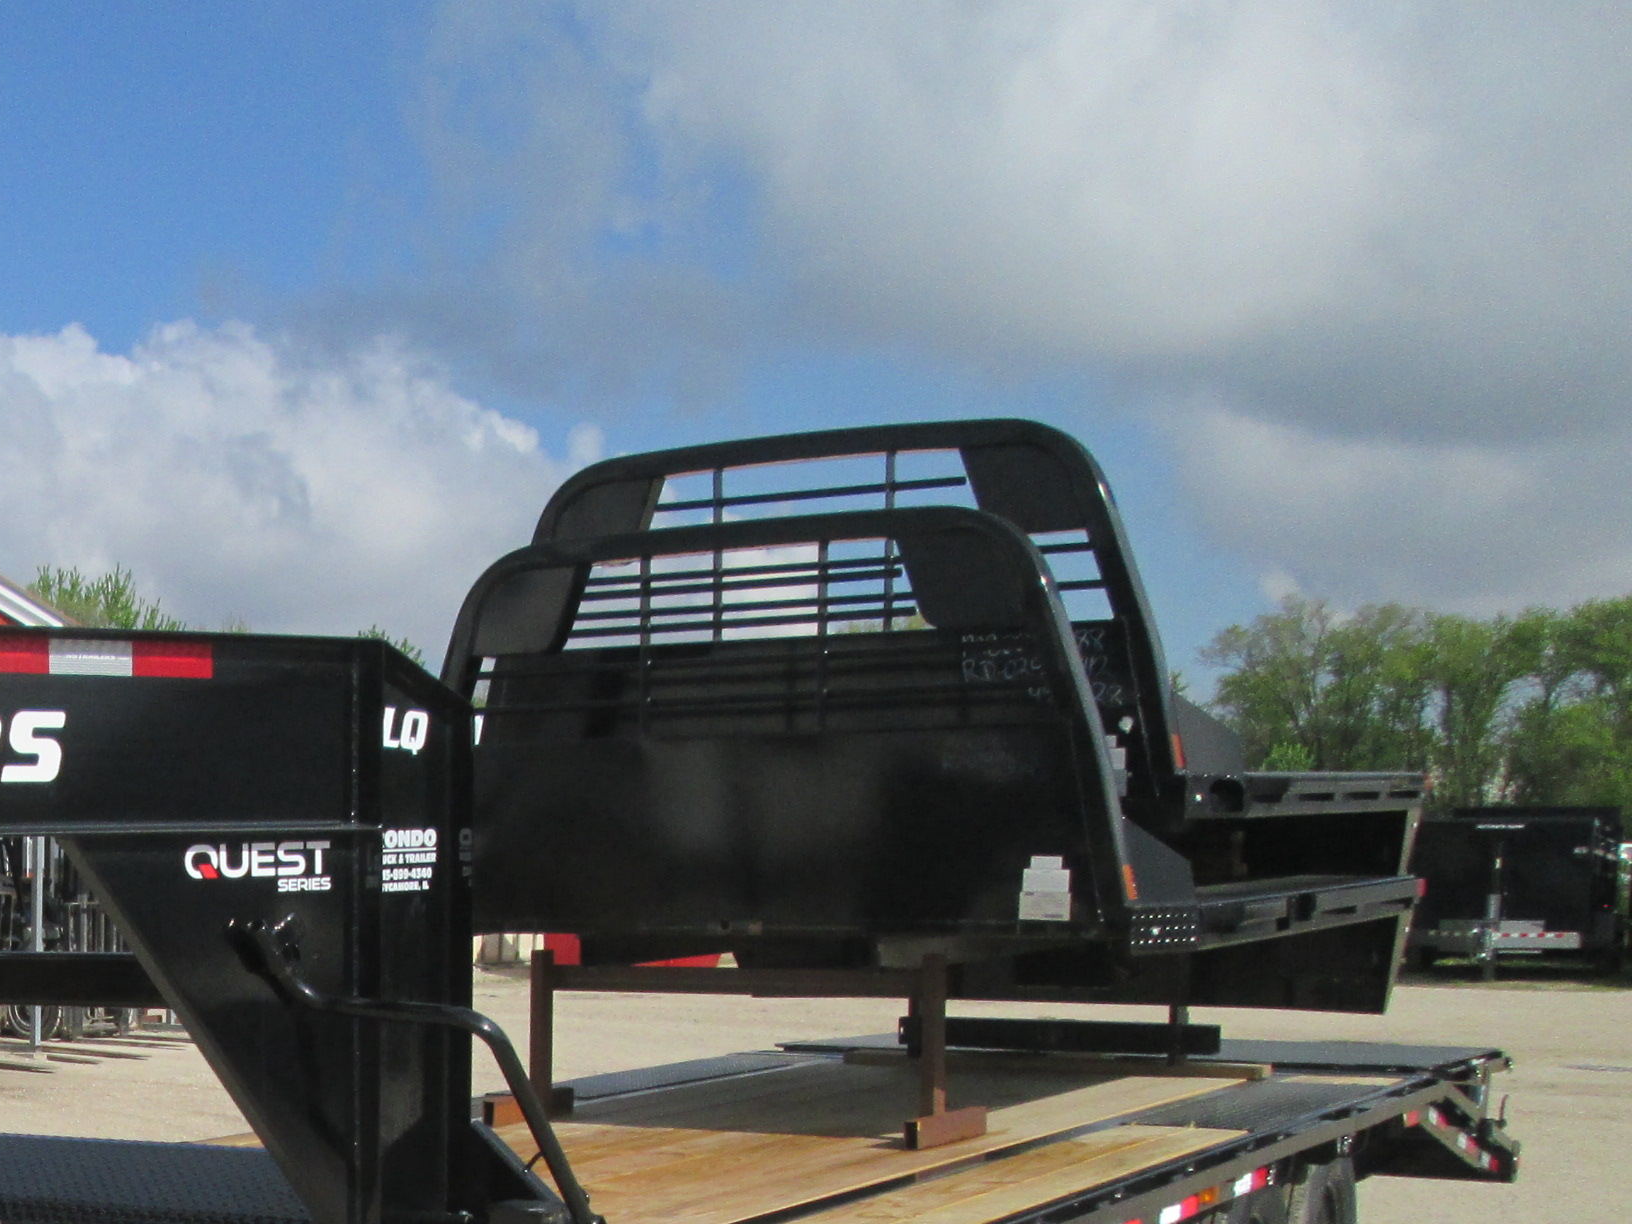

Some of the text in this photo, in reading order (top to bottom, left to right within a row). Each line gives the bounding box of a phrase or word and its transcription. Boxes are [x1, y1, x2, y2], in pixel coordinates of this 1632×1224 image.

[382, 706, 429, 756] LQ
[382, 828, 437, 849] ONDO
[184, 841, 331, 880] QUEST
[382, 853, 397, 866] UCK
[405, 852, 437, 864] TRAILER
[277, 877, 332, 893] SERIES
